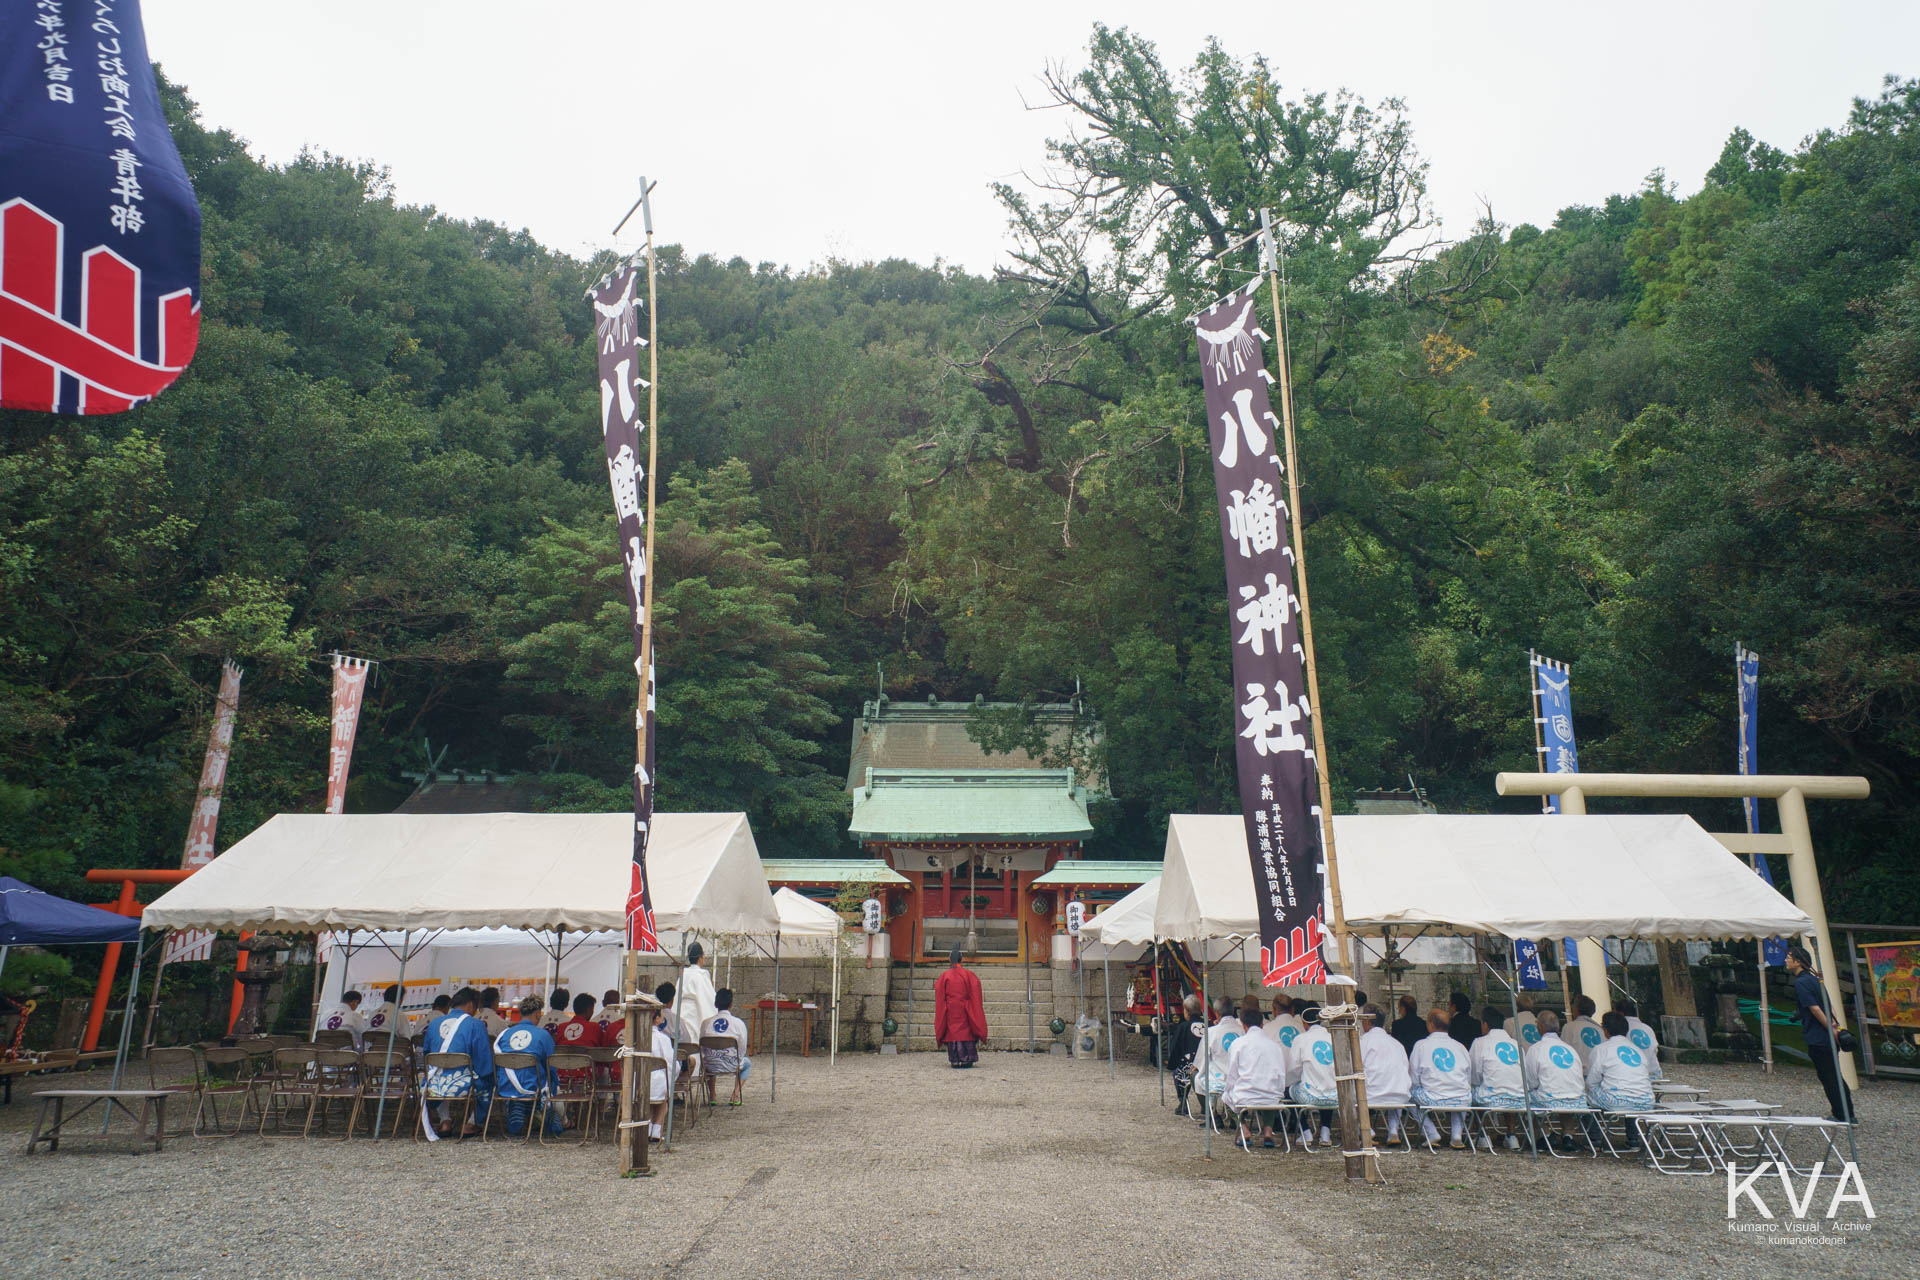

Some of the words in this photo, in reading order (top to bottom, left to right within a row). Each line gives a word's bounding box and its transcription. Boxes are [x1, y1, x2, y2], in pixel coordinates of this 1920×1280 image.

[1218, 388, 1306, 757] 八幡神社
[1260, 773, 1274, 801] 奉納
[1255, 809, 1287, 923] 勝浦漁業協同組合
[1271, 803, 1297, 907] 平成二十八年九月吉日
